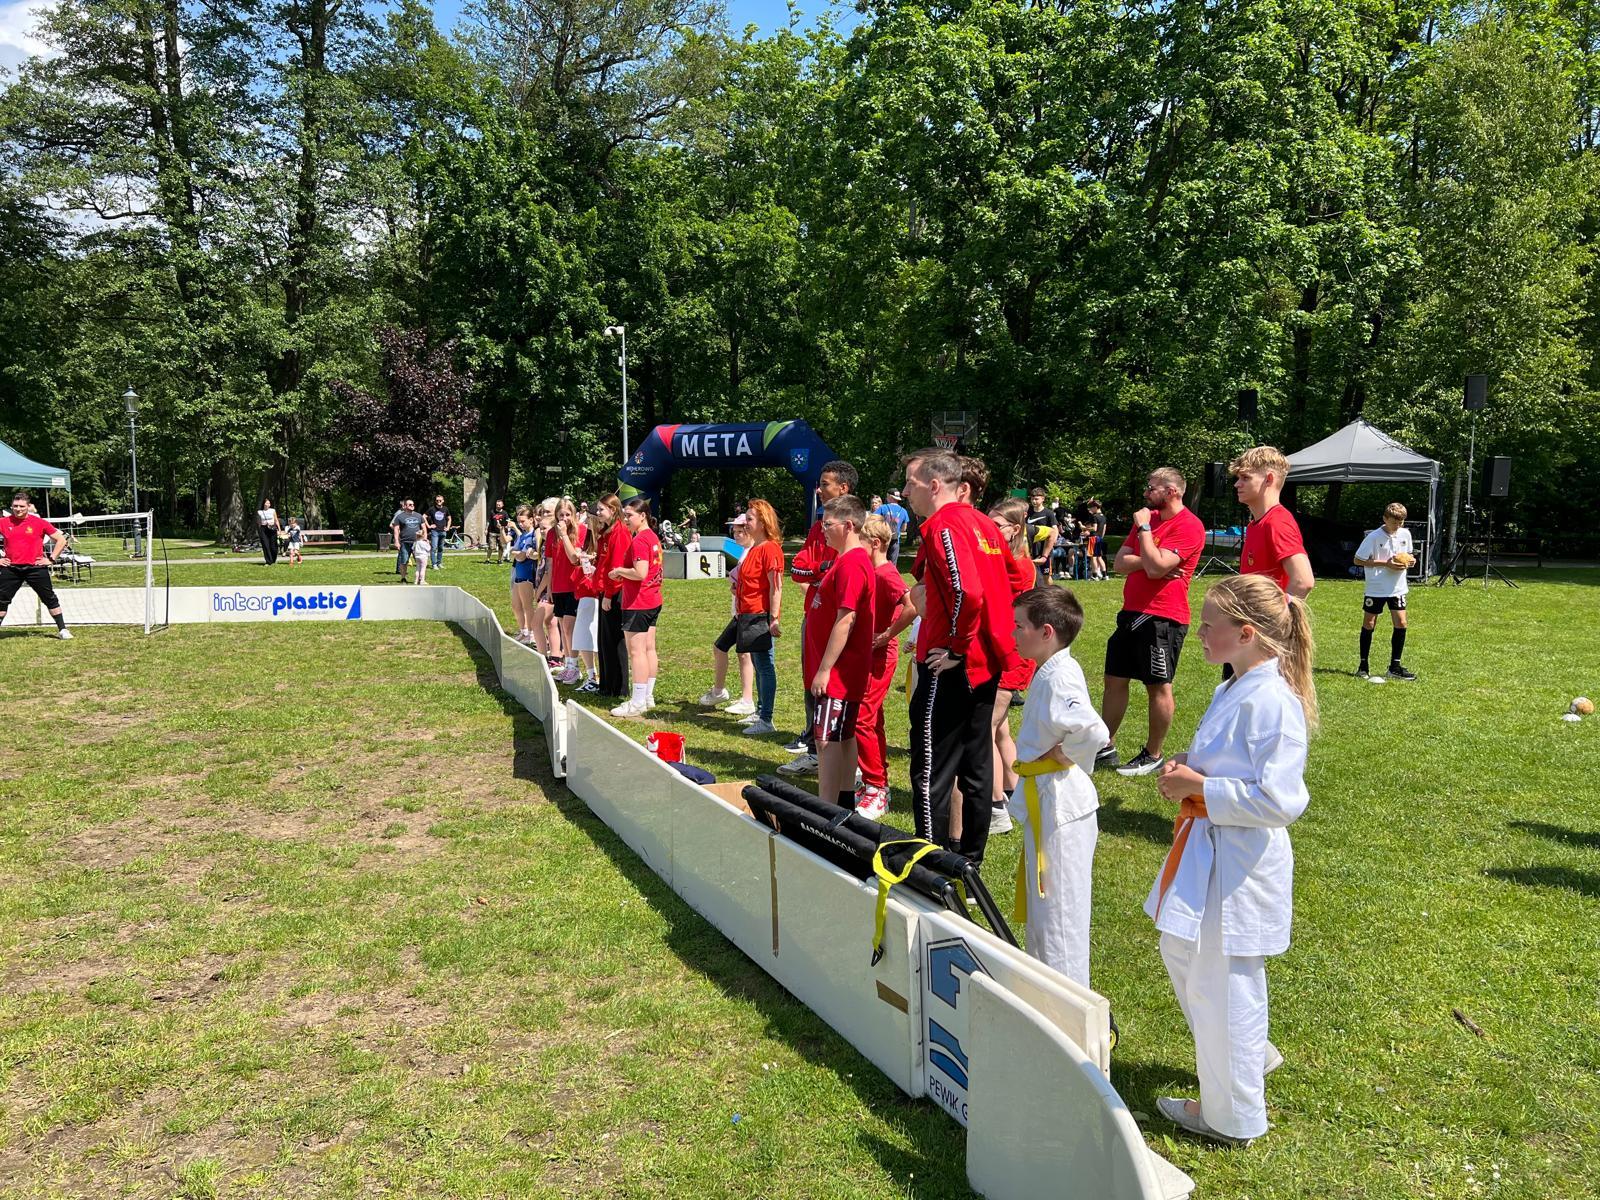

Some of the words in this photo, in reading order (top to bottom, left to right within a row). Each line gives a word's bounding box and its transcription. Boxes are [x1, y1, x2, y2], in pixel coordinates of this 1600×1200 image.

[681, 433, 752, 457] META
[213, 592, 347, 616] interplastic
[1150, 645, 1168, 679] NIKE
[929, 1075, 959, 1113] PEWIK
